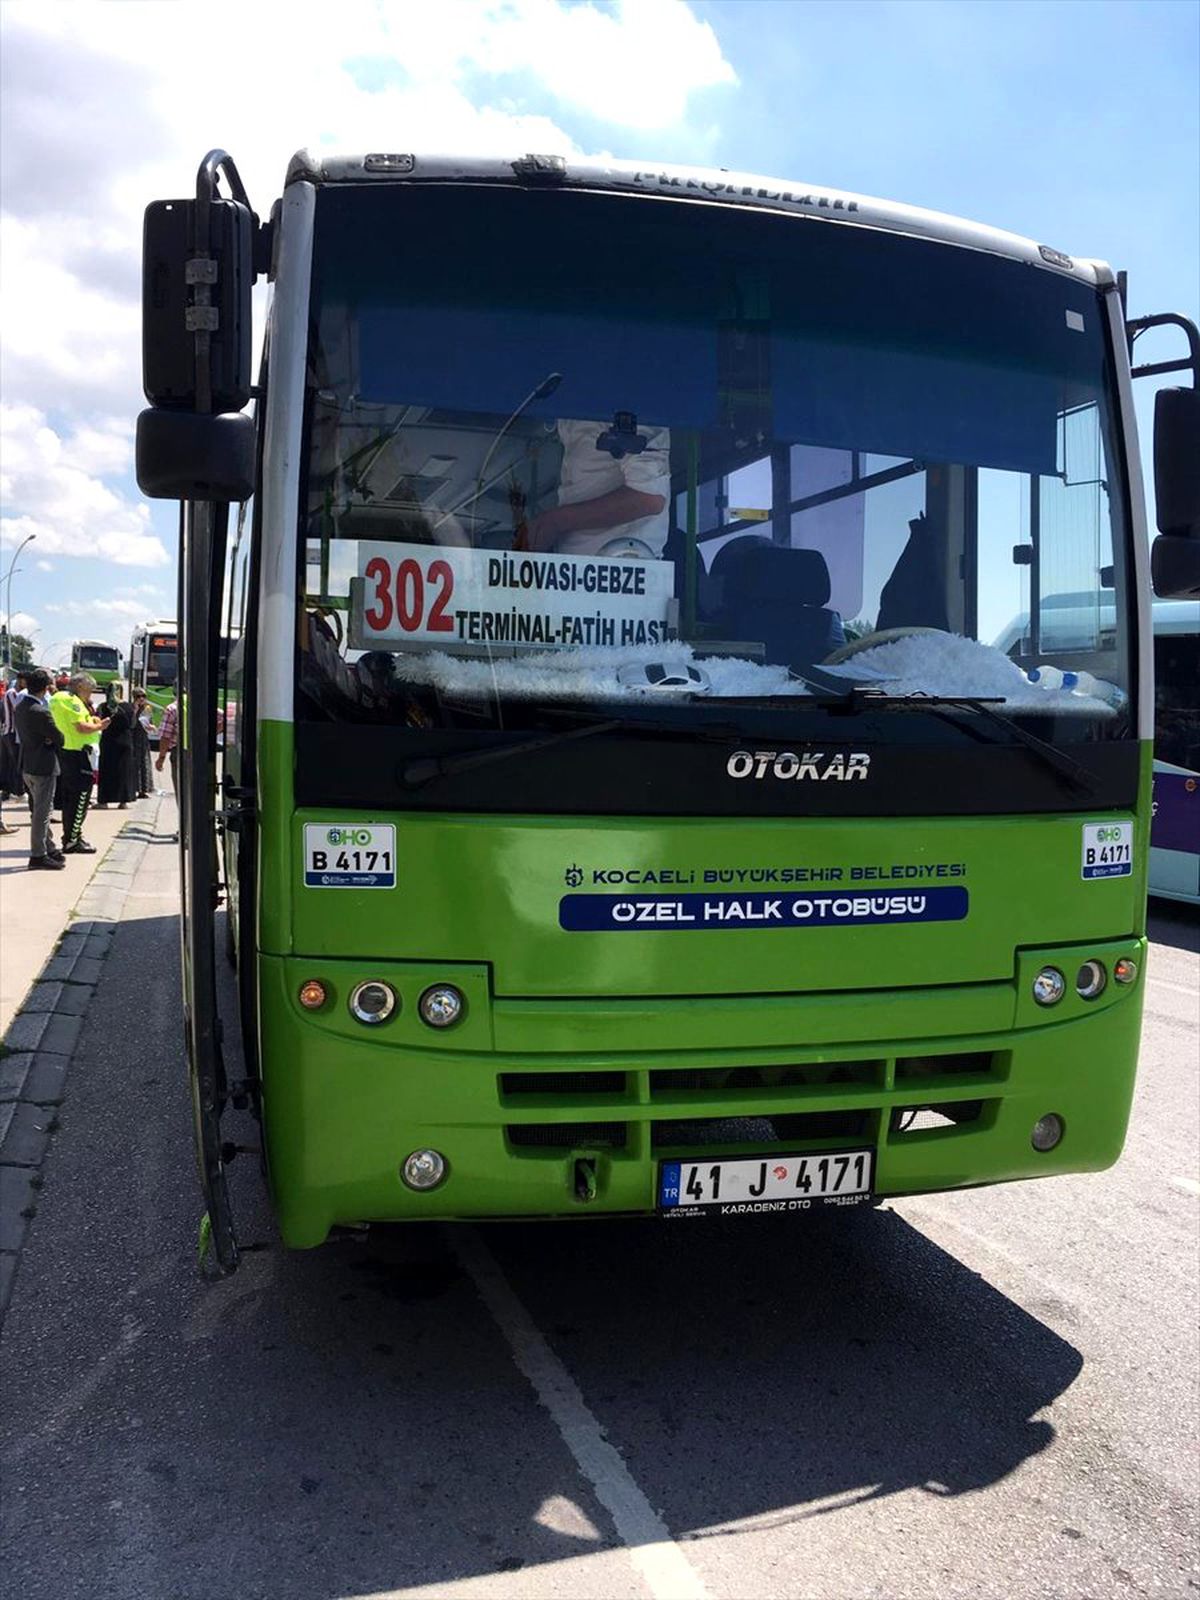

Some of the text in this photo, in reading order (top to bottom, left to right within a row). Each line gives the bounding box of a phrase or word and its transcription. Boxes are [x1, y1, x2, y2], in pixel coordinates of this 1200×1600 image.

[488, 552, 646, 595] DİLOVASI-GEBZE
[365, 557, 454, 632] 302
[455, 606, 615, 646] TERMİNAL-FATİH
[726, 751, 871, 781] OTOKAR
[312, 851, 391, 871] B 4171
[1086, 844, 1129, 864] B 4171
[611, 896, 926, 922] ÖZEL HALK OTOBÜSÜ
[664, 1154, 865, 1200] TR 41 J 4171
[788, 1200, 811, 1210] OTO
